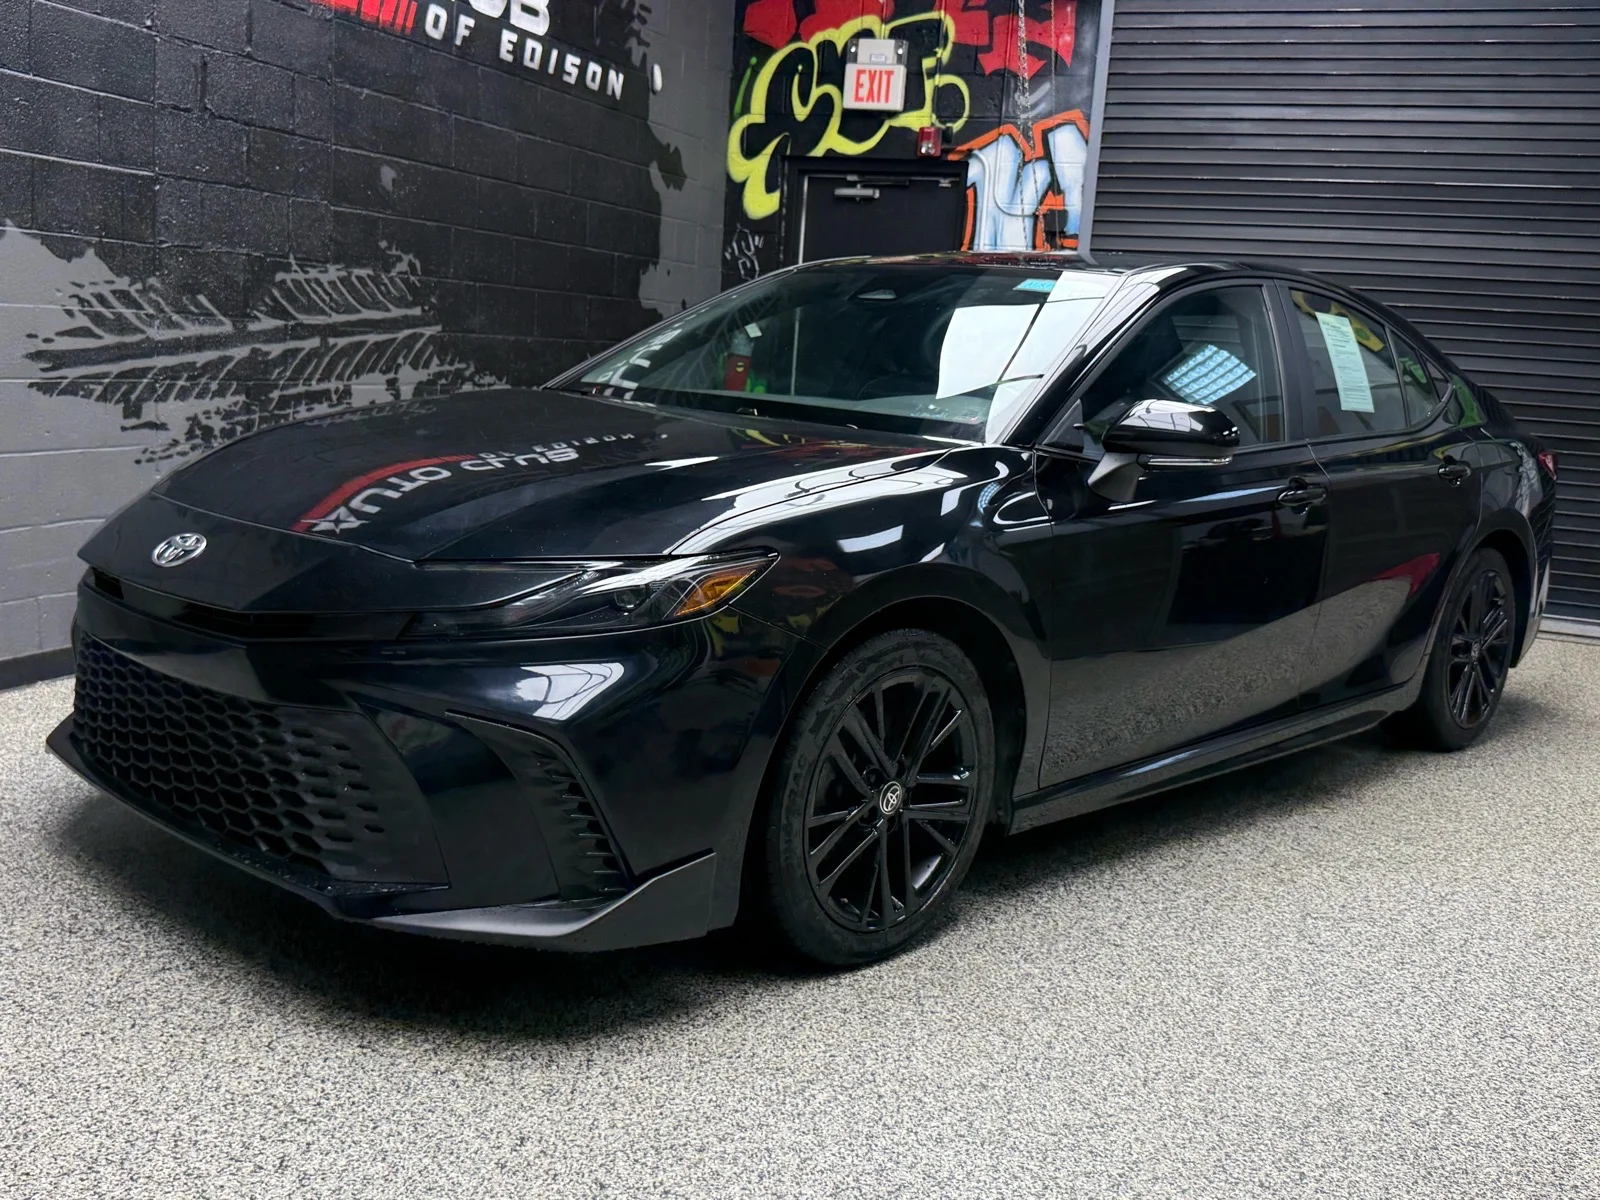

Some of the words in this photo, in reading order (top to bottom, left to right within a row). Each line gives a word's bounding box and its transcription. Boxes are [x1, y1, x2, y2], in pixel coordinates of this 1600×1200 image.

[424, 3, 475, 46] OF
[500, 28, 625, 100] EDISON
[854, 69, 895, 103] EXIT
